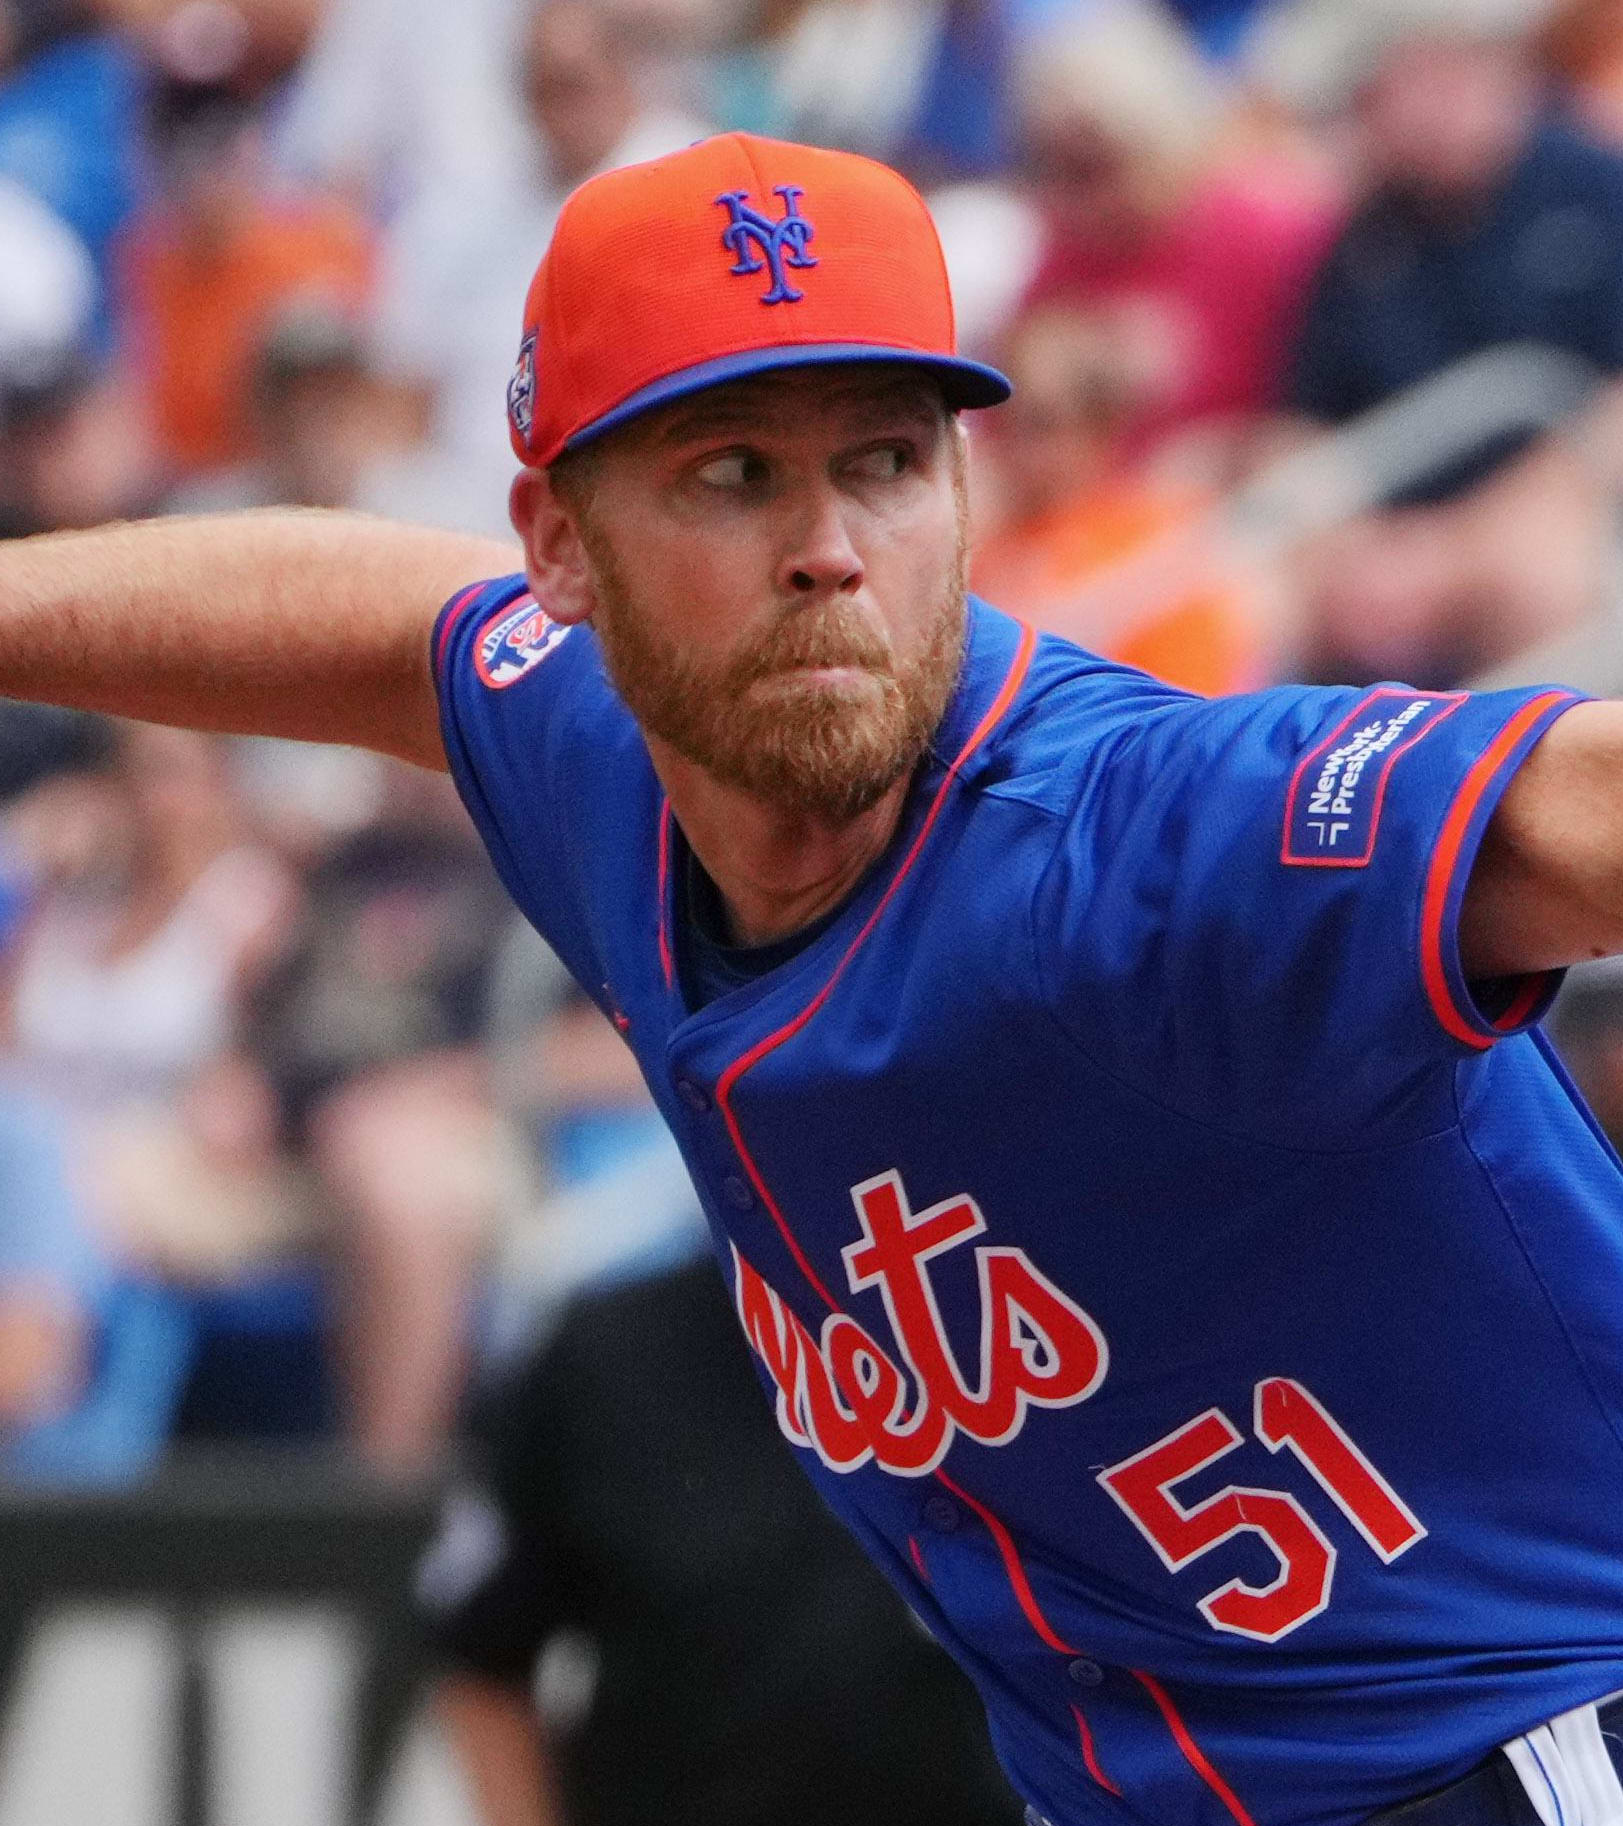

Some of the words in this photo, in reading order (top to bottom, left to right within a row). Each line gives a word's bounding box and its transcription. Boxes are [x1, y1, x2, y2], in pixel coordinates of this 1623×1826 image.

[715, 185, 819, 304] NY
[1330, 700, 1432, 815] Presbterian
[1095, 1375, 1429, 1643] 51
